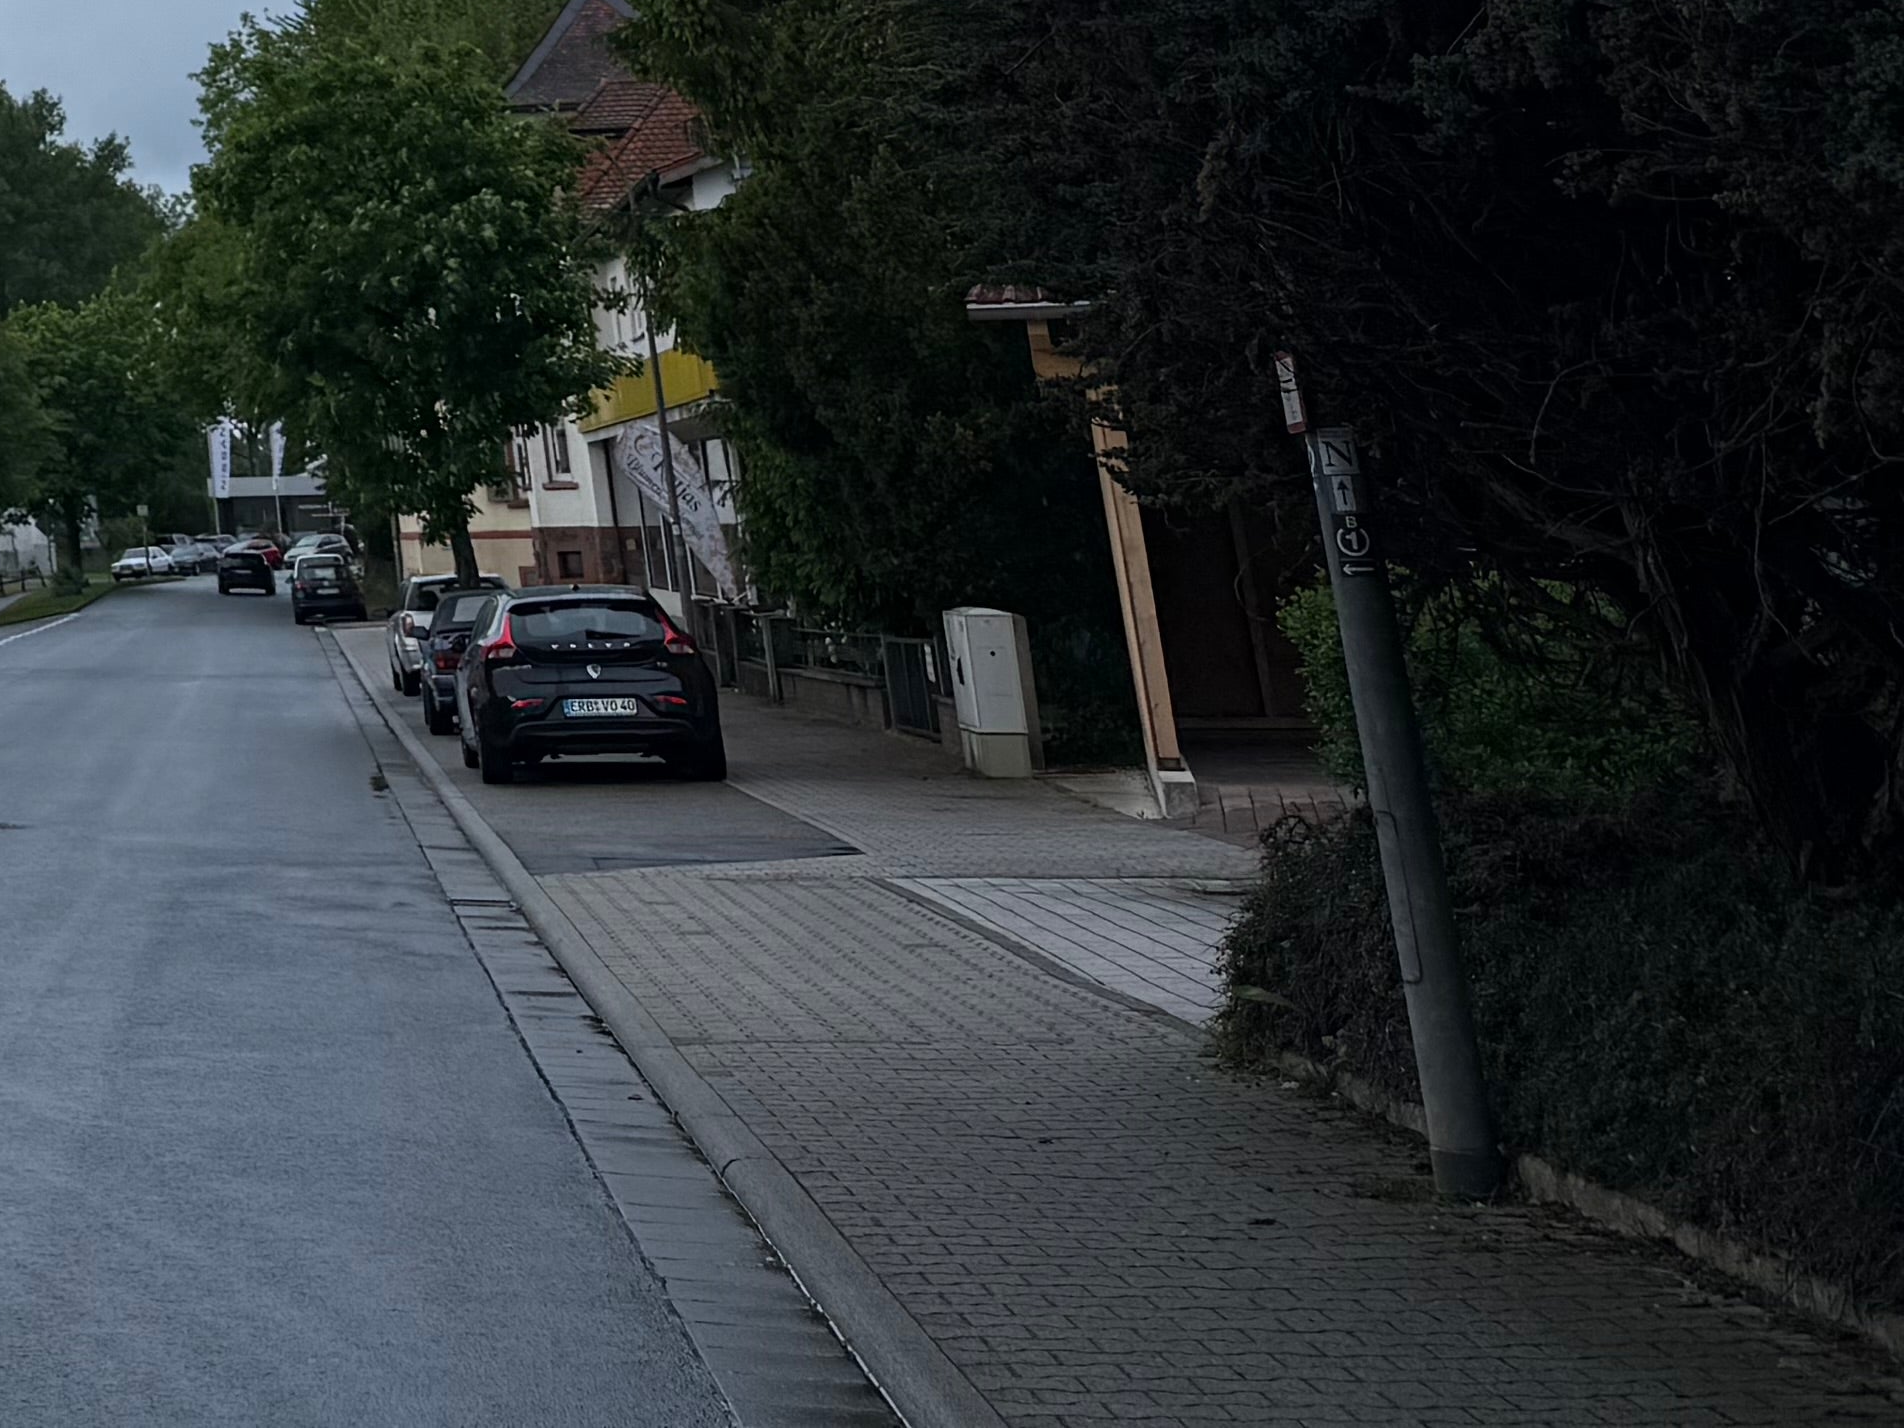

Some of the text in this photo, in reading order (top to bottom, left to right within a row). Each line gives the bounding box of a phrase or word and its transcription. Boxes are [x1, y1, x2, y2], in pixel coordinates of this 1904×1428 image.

[1321, 440, 1353, 467] N
[1345, 531, 1359, 551] 1
[570, 700, 594, 712] ERB
[620, 699, 635, 711] 40
